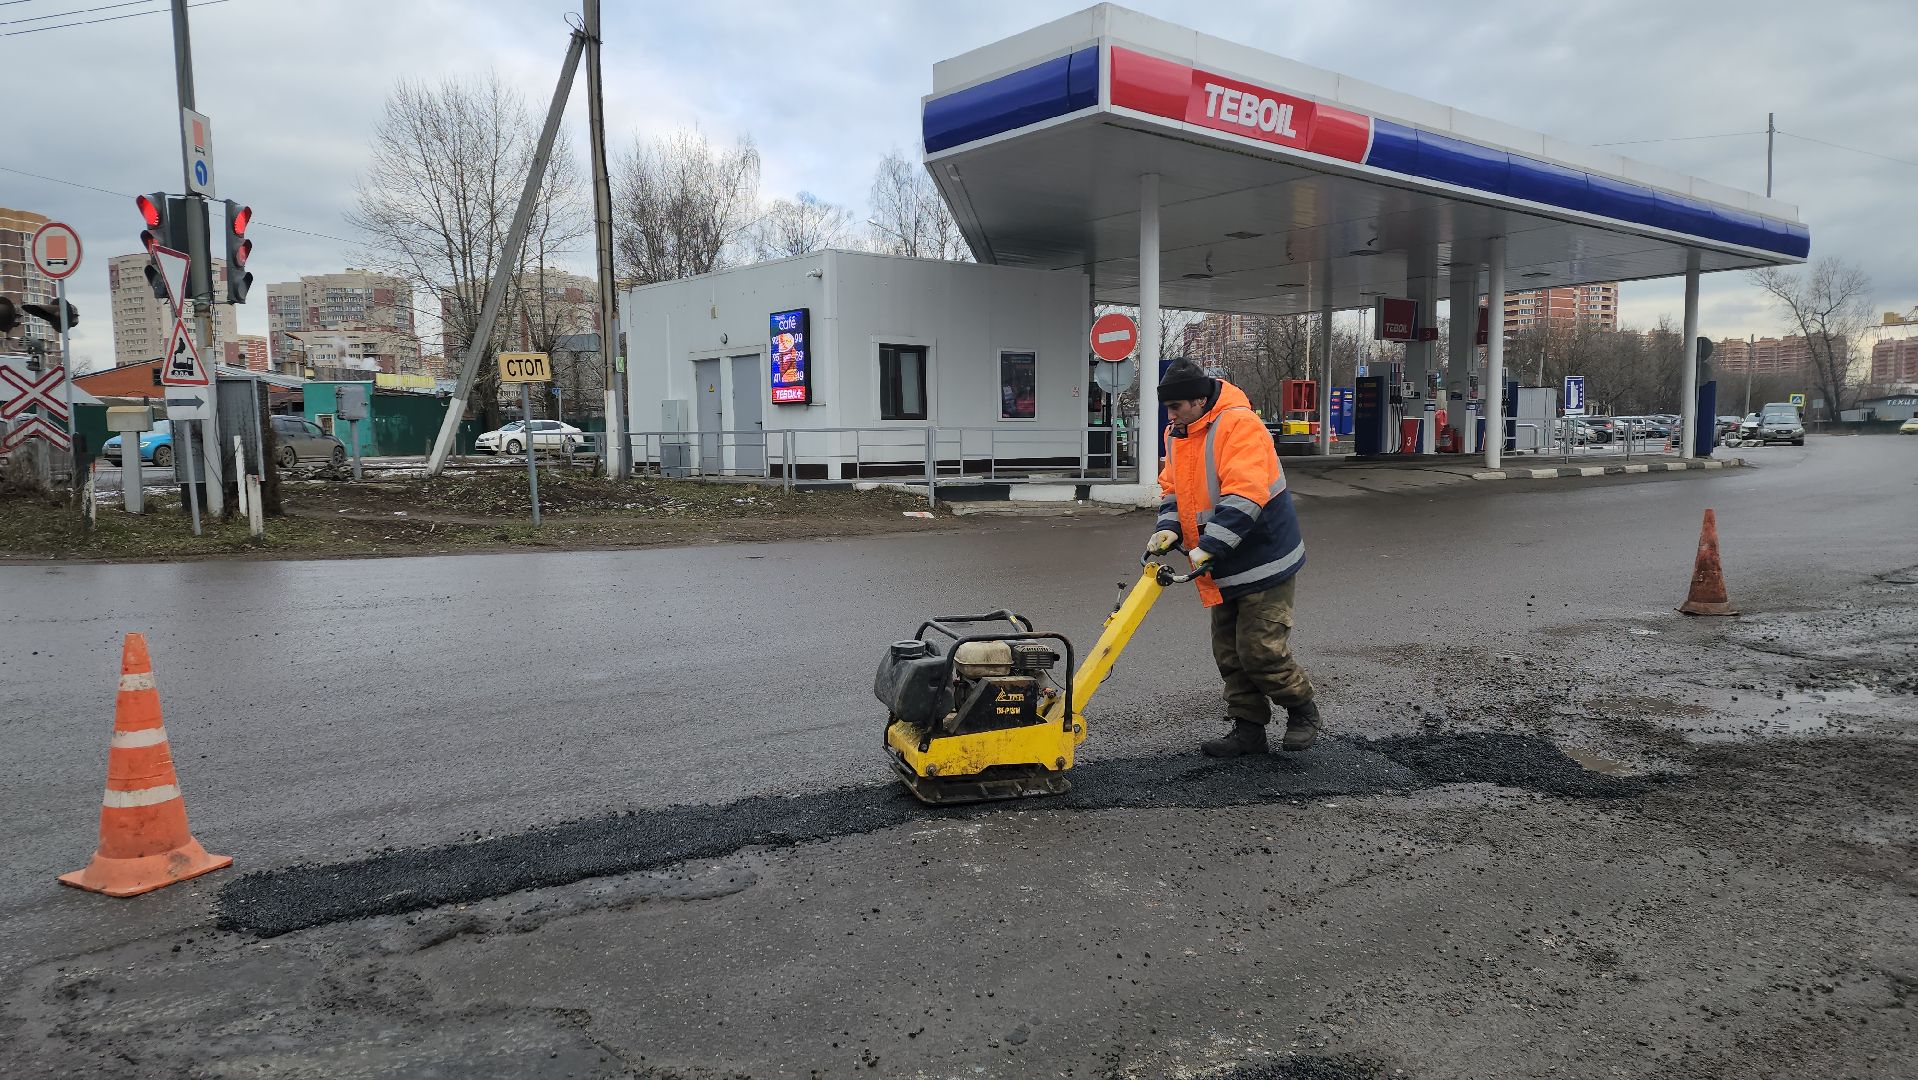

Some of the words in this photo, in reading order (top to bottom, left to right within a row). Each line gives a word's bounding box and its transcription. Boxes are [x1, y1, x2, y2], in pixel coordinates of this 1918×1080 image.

[1204, 82, 1297, 139] TEBOIL
[779, 315, 796, 331] café
[1386, 323, 1408, 333] TEBOIL
[506, 358, 545, 377] СТОП
[1406, 436, 1412, 446] 3
